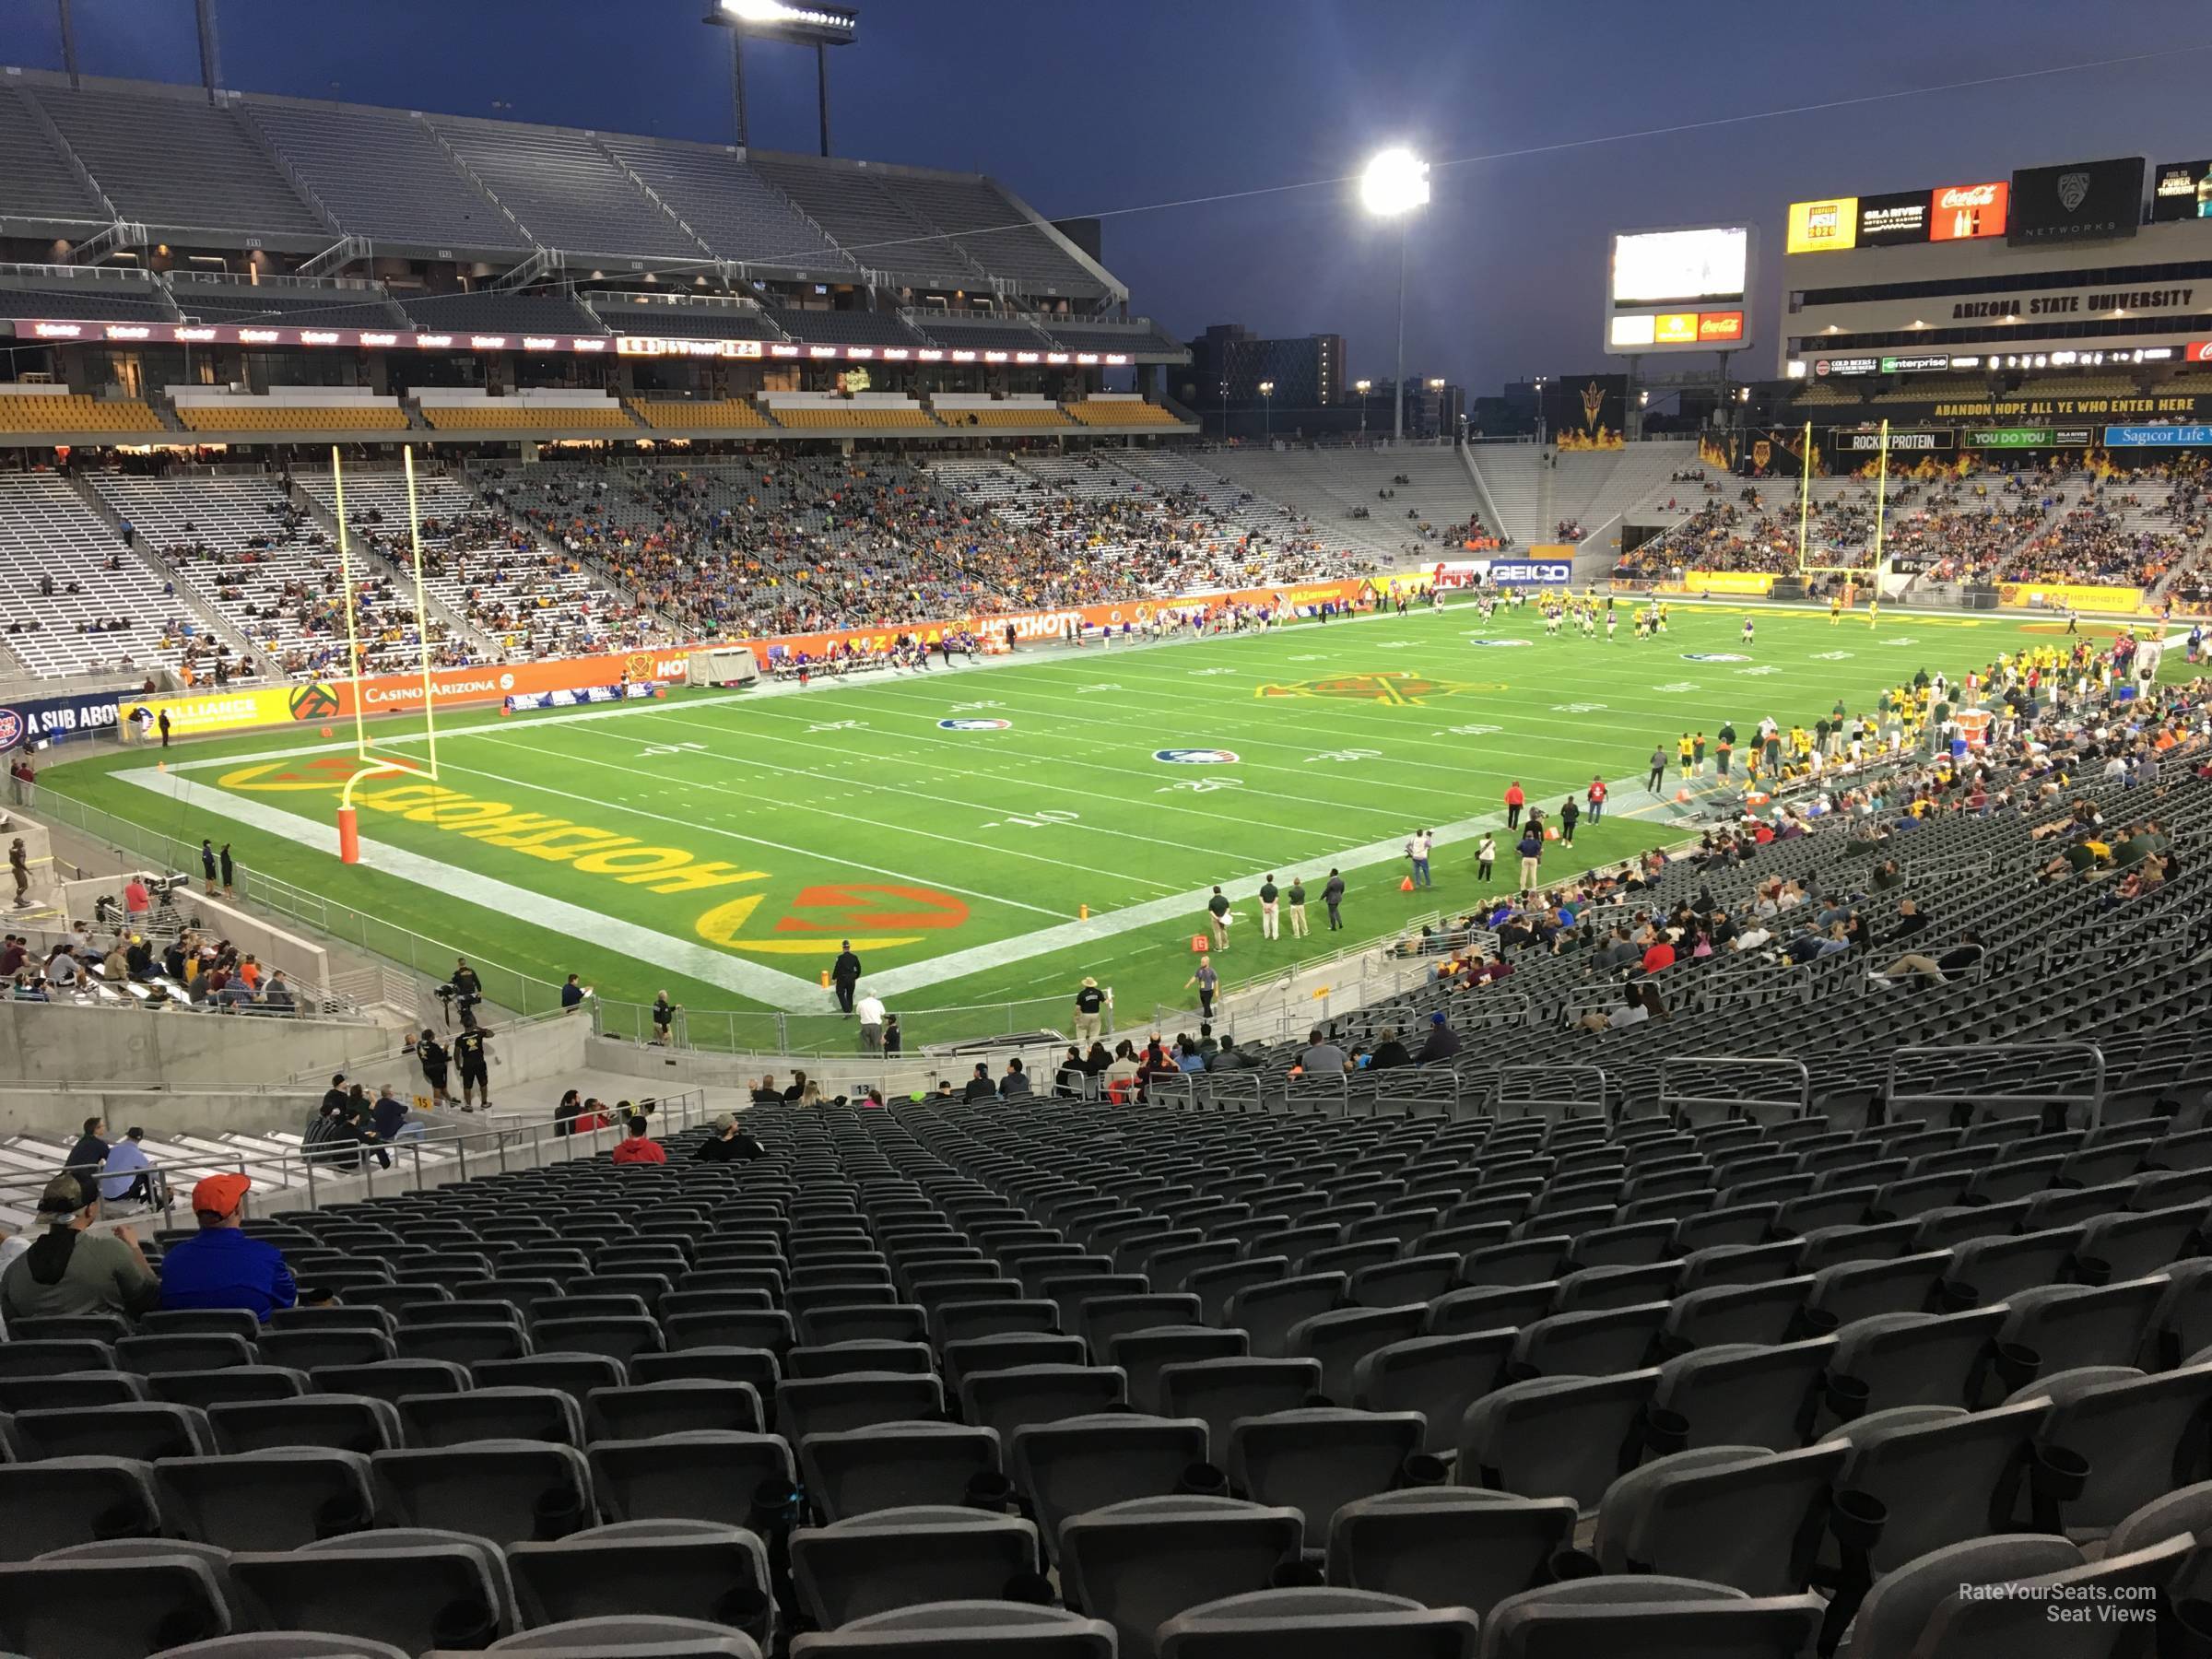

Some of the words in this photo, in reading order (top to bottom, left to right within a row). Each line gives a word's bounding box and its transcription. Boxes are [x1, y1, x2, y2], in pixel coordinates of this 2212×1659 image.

[2162, 177, 2191, 187] POWER
[1865, 209, 1889, 219] GILA
[1890, 206, 1923, 218] RIVER
[2026, 221, 2116, 237] NETWORKS
[1952, 300, 2020, 318] ARIZONA
[2030, 296, 2079, 314] STATE
[2088, 288, 2194, 311] UNIVERSITY
[1885, 358, 1947, 369] enterprise
[1935, 403, 1992, 416] ABANDON
[1994, 403, 2028, 415] HOPE
[2030, 402, 2053, 414] ALL
[2057, 402, 2073, 413] YE
[2077, 401, 2108, 413] WHO
[2112, 399, 2154, 412] ENTER
[2159, 398, 2195, 411] HERE
[1892, 435, 1936, 449] PROTEIN
[1974, 434, 1998, 444] YOU
[2001, 433, 2019, 443] DO
[2021, 433, 2045, 443] YOU
[1491, 565, 1570, 582] GEICO
[165, 699, 257, 719] ALLIANCE
[28, 713, 40, 734] A
[41, 708, 76, 731] SUB
[80, 703, 119, 728] ABOV
[1173, 777, 1244, 793] 20
[1005, 809, 1080, 829] 10
[332, 784, 773, 894] HOTSHOTS
[856, 1085, 869, 1095] 13
[418, 1097, 428, 1108] 15
